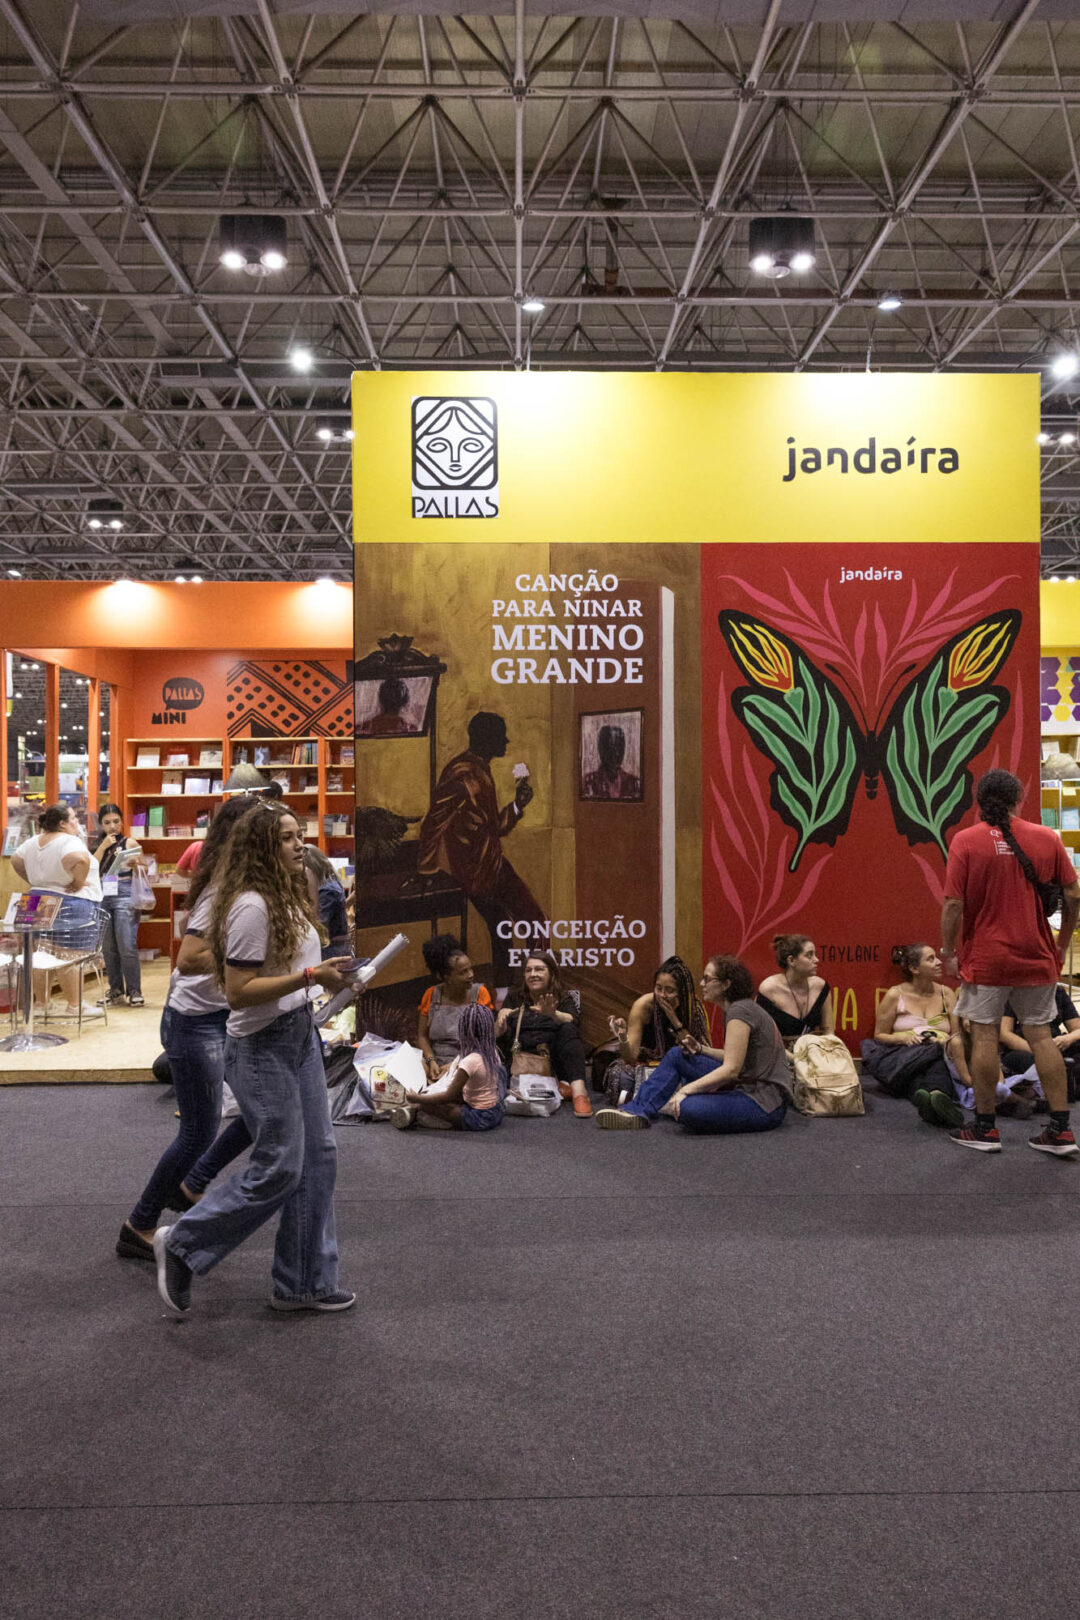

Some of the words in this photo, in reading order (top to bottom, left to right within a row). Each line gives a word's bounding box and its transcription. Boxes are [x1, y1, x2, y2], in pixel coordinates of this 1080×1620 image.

[782, 436, 960, 482] jandaíra
[411, 496, 499, 519] PALLAS
[514, 569, 619, 597] CANÇÃO
[839, 566, 903, 584] jandaíra
[491, 599, 556, 618] PARA
[562, 599, 644, 618] NINAR
[491, 623, 644, 651] MENINO
[490, 657, 644, 685] GRANDE
[165, 687, 202, 700] PALLAS
[151, 711, 187, 725] MINI
[495, 914, 647, 945] CONCEIÇÃO
[819, 944, 880, 963] TAYLANE
